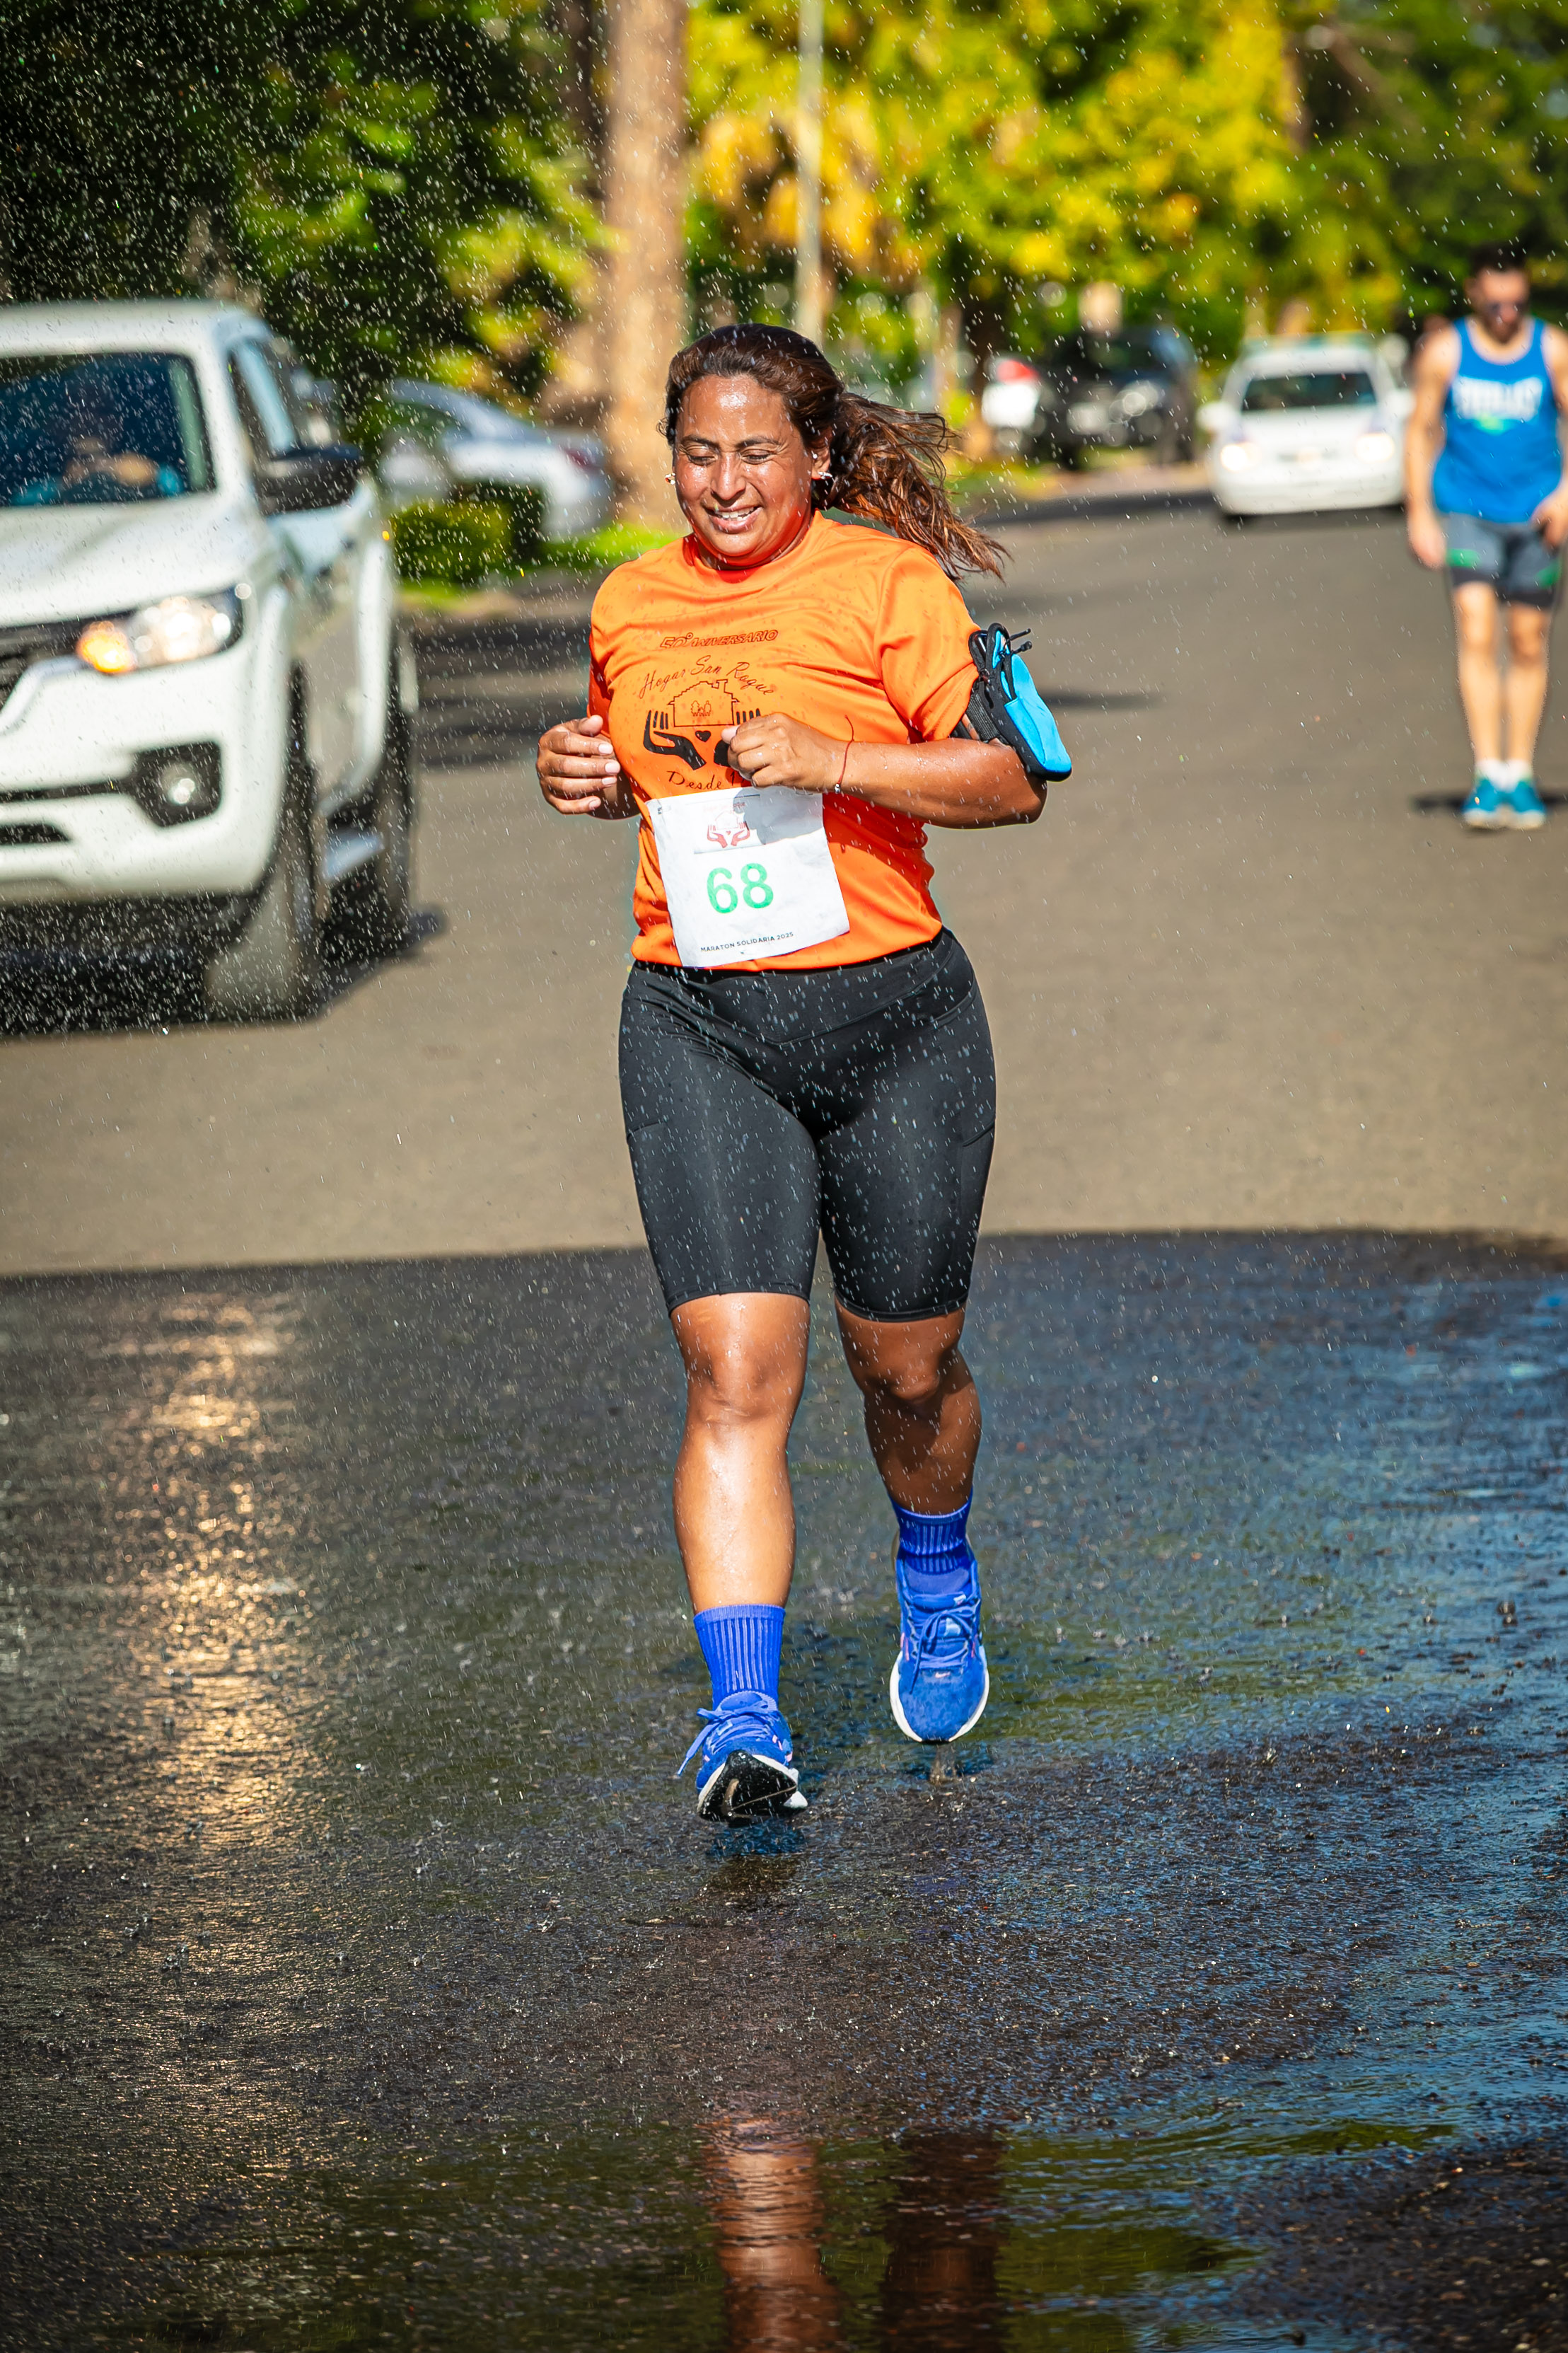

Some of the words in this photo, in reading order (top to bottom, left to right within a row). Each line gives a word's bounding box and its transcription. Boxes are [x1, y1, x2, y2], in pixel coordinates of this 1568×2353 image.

[691, 629, 779, 647] ANIVERSARIO
[639, 669, 685, 699] Hogar
[690, 654, 722, 675] San
[666, 770, 722, 790] Desde
[707, 862, 774, 914] 68
[700, 942, 736, 953] MARATON
[736, 936, 775, 947] SOLIDARIA
[777, 932, 794, 940] 2025
